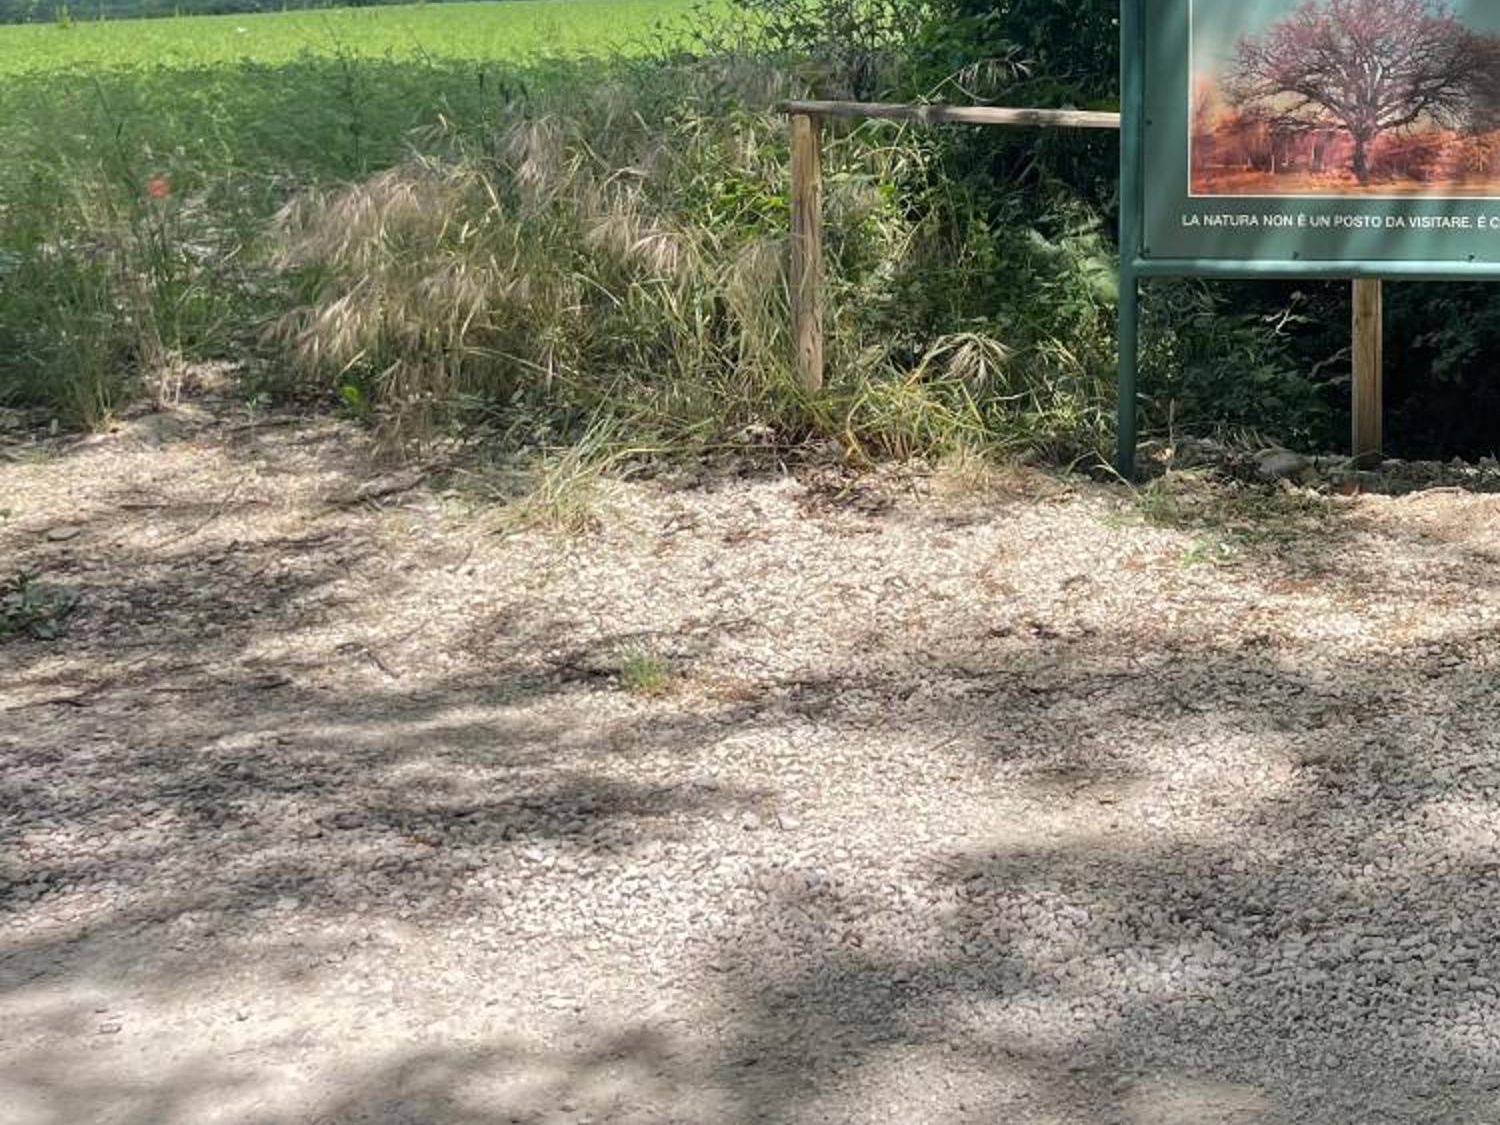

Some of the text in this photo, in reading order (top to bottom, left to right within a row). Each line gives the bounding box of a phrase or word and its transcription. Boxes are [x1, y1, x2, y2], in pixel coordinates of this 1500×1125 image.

[1181, 214, 1200, 226] LA
[1203, 214, 1259, 227] NATURA
[1263, 214, 1293, 227] NON
[1309, 215, 1330, 227] UN
[1333, 215, 1382, 228] POSTO
[1385, 216, 1405, 228] DA
